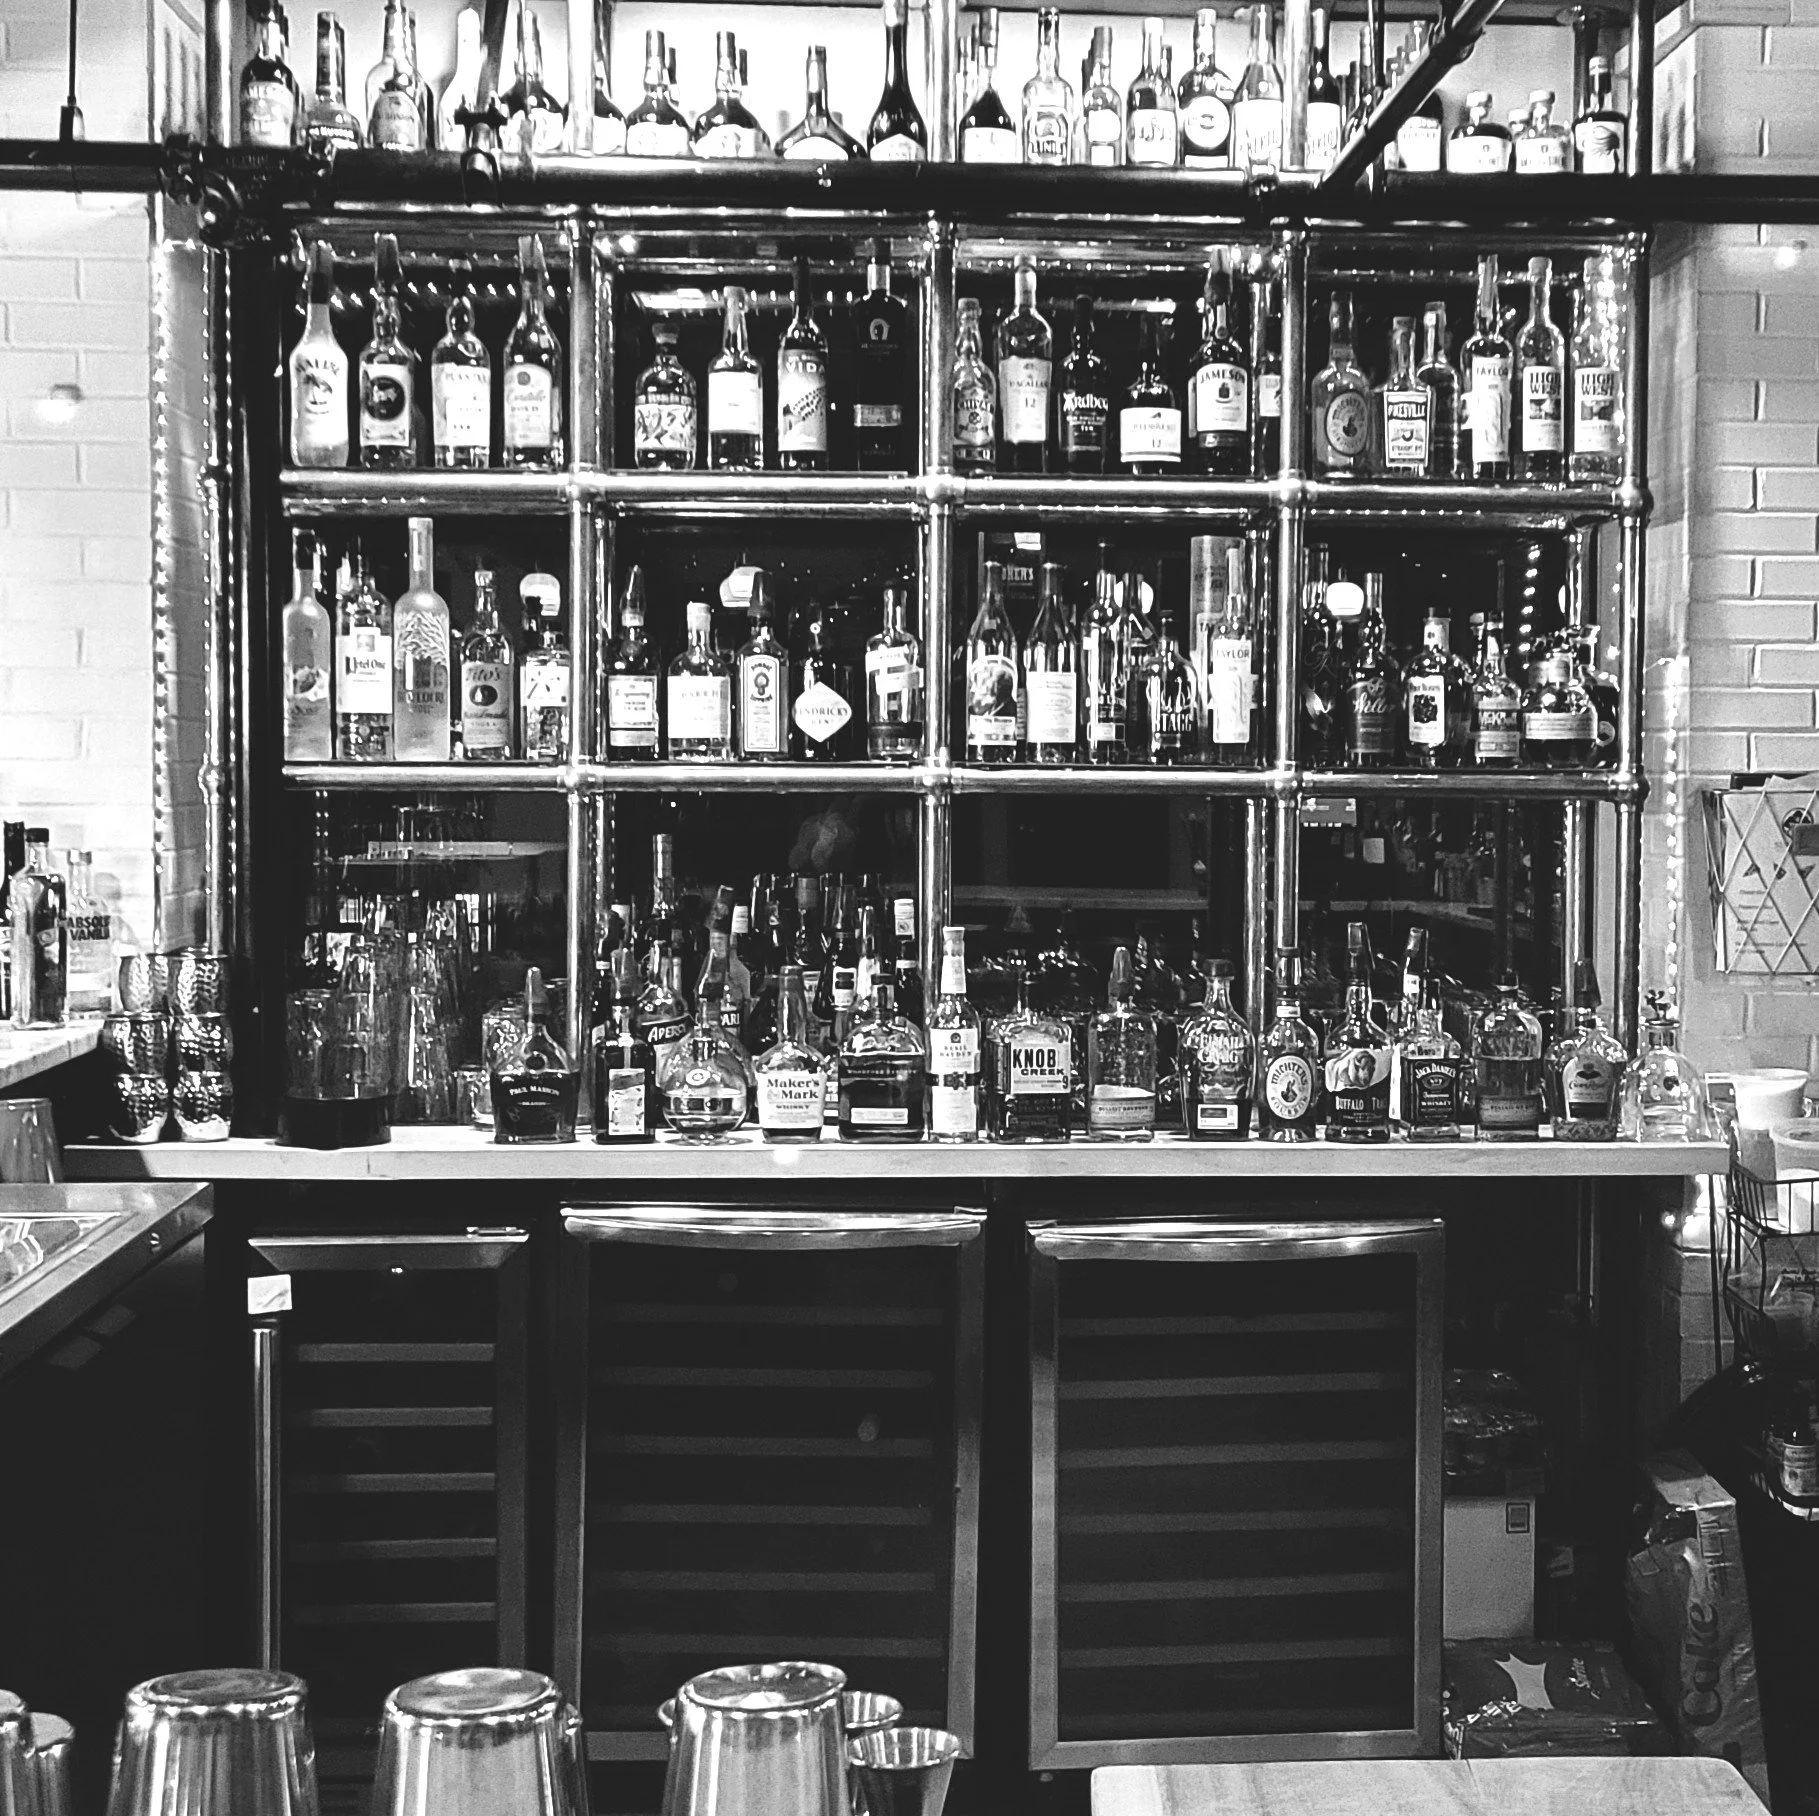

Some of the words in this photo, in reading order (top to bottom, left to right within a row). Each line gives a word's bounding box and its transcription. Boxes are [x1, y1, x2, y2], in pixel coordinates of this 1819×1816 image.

[785, 362, 825, 373] VIDA
[1200, 368, 1246, 384] JAMESON
[1530, 372, 1561, 384] HIGH
[1581, 373, 1614, 385] HIGH
[1530, 384, 1561, 395] WEST
[1581, 384, 1614, 396] WEST
[466, 666, 501, 681] Tito's
[1012, 1048, 1056, 1069] KNOB
[1020, 1068, 1064, 1076] CREEK
[767, 1078, 820, 1088] Maker's
[1062, 1075, 1069, 1090] 9
[509, 1087, 528, 1096] PAUL
[781, 1089, 819, 1099] Mark
[1335, 1095, 1365, 1110] BUFFALO
[1681, 1603, 1723, 1727] Coke
